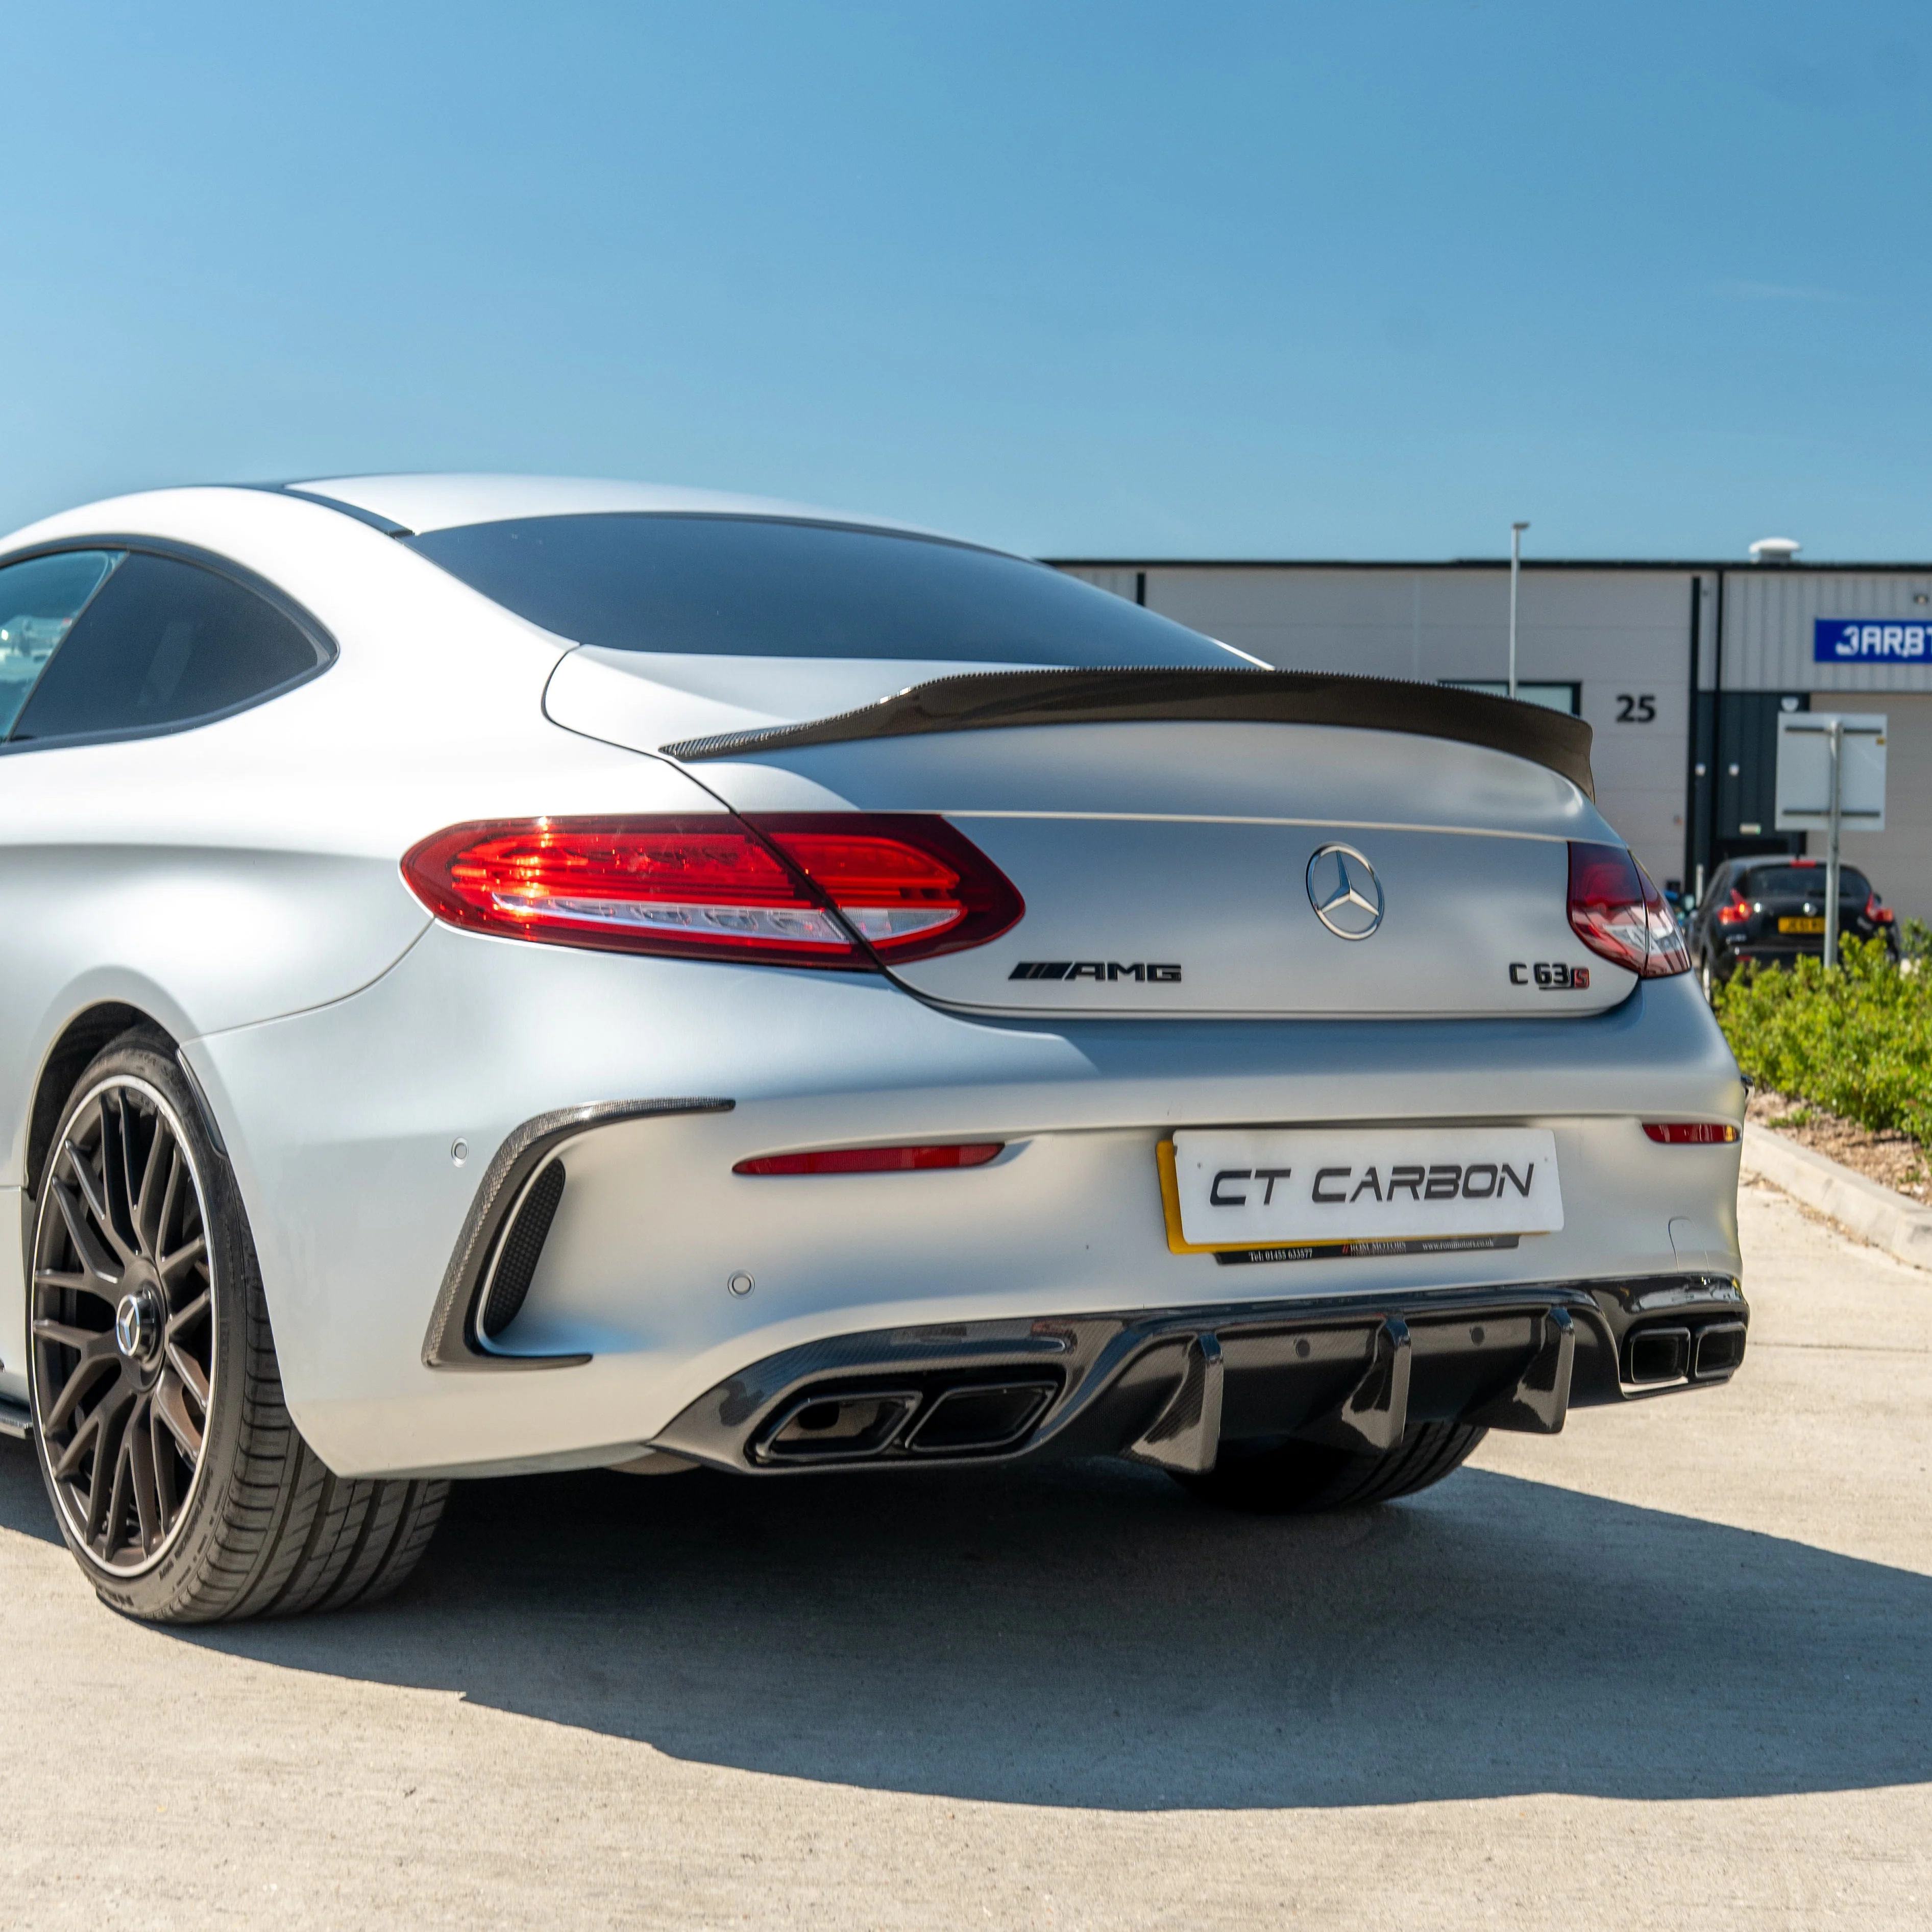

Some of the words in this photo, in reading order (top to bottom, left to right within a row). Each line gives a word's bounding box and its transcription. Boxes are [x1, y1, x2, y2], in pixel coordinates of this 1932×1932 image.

[1616, 695, 1656, 723] 25
[1064, 961, 1182, 982] AMG
[1209, 1168, 1291, 1206] CT
[1311, 1162, 1535, 1204] CARBON
